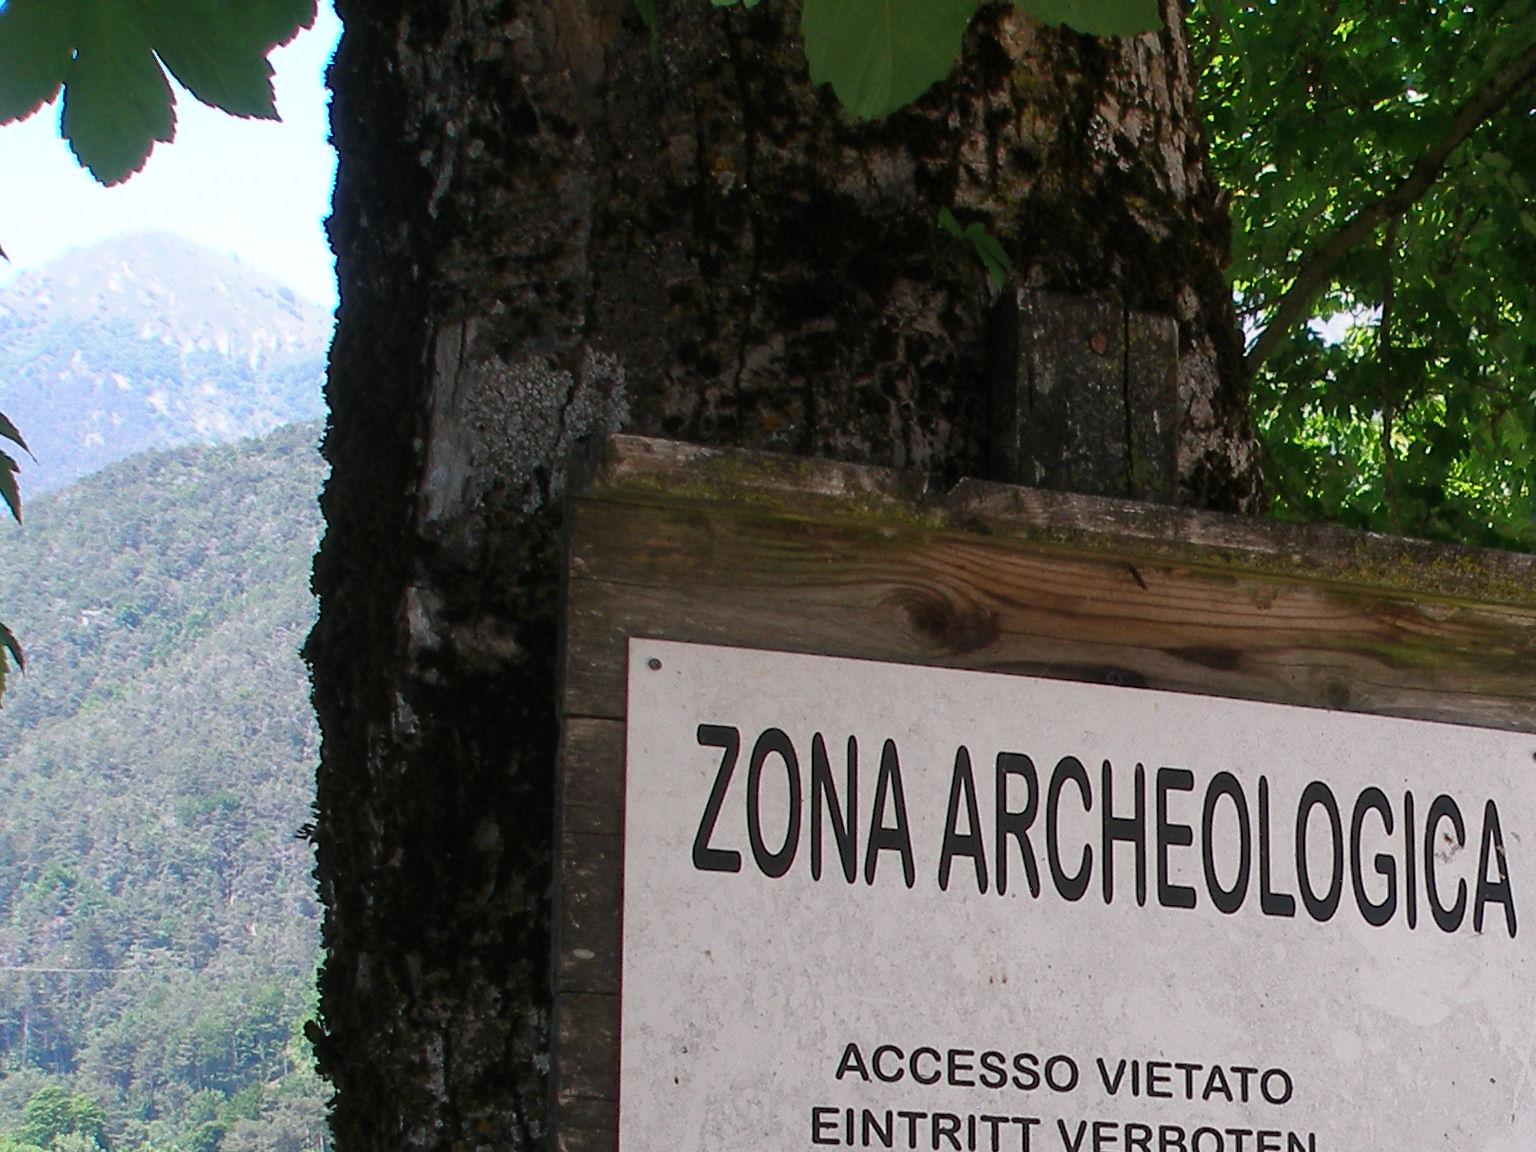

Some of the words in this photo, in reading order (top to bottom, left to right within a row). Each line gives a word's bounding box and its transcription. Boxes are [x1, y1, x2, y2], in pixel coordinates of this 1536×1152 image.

[691, 723, 916, 890] ZONA
[937, 744, 1518, 939] ARCHEOLOGICA
[835, 1042, 1079, 1093] ACCESSO
[1095, 1057, 1294, 1105] VIETATO
